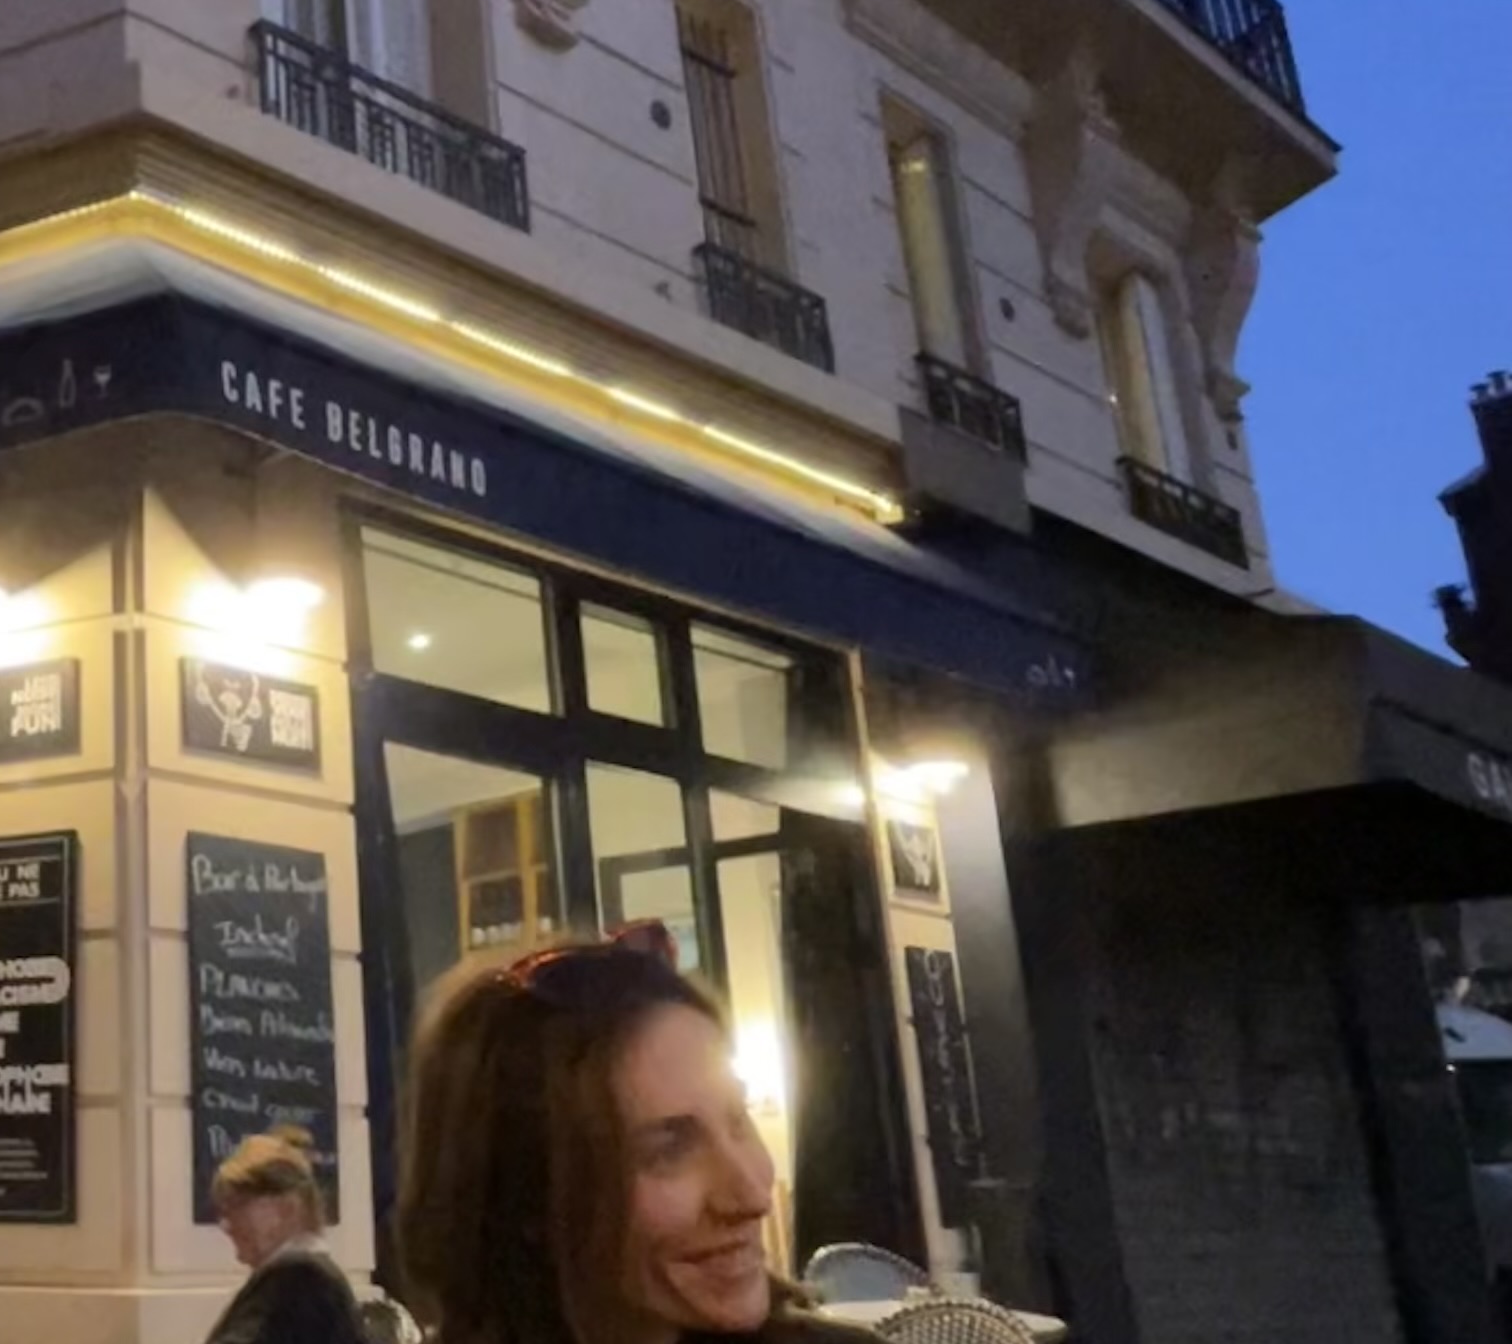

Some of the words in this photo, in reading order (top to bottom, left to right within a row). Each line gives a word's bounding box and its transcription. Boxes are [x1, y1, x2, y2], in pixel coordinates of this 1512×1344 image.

[221, 360, 306, 430] CAFE
[325, 400, 487, 498] BELGRANO
[8, 881, 40, 897] PAS
